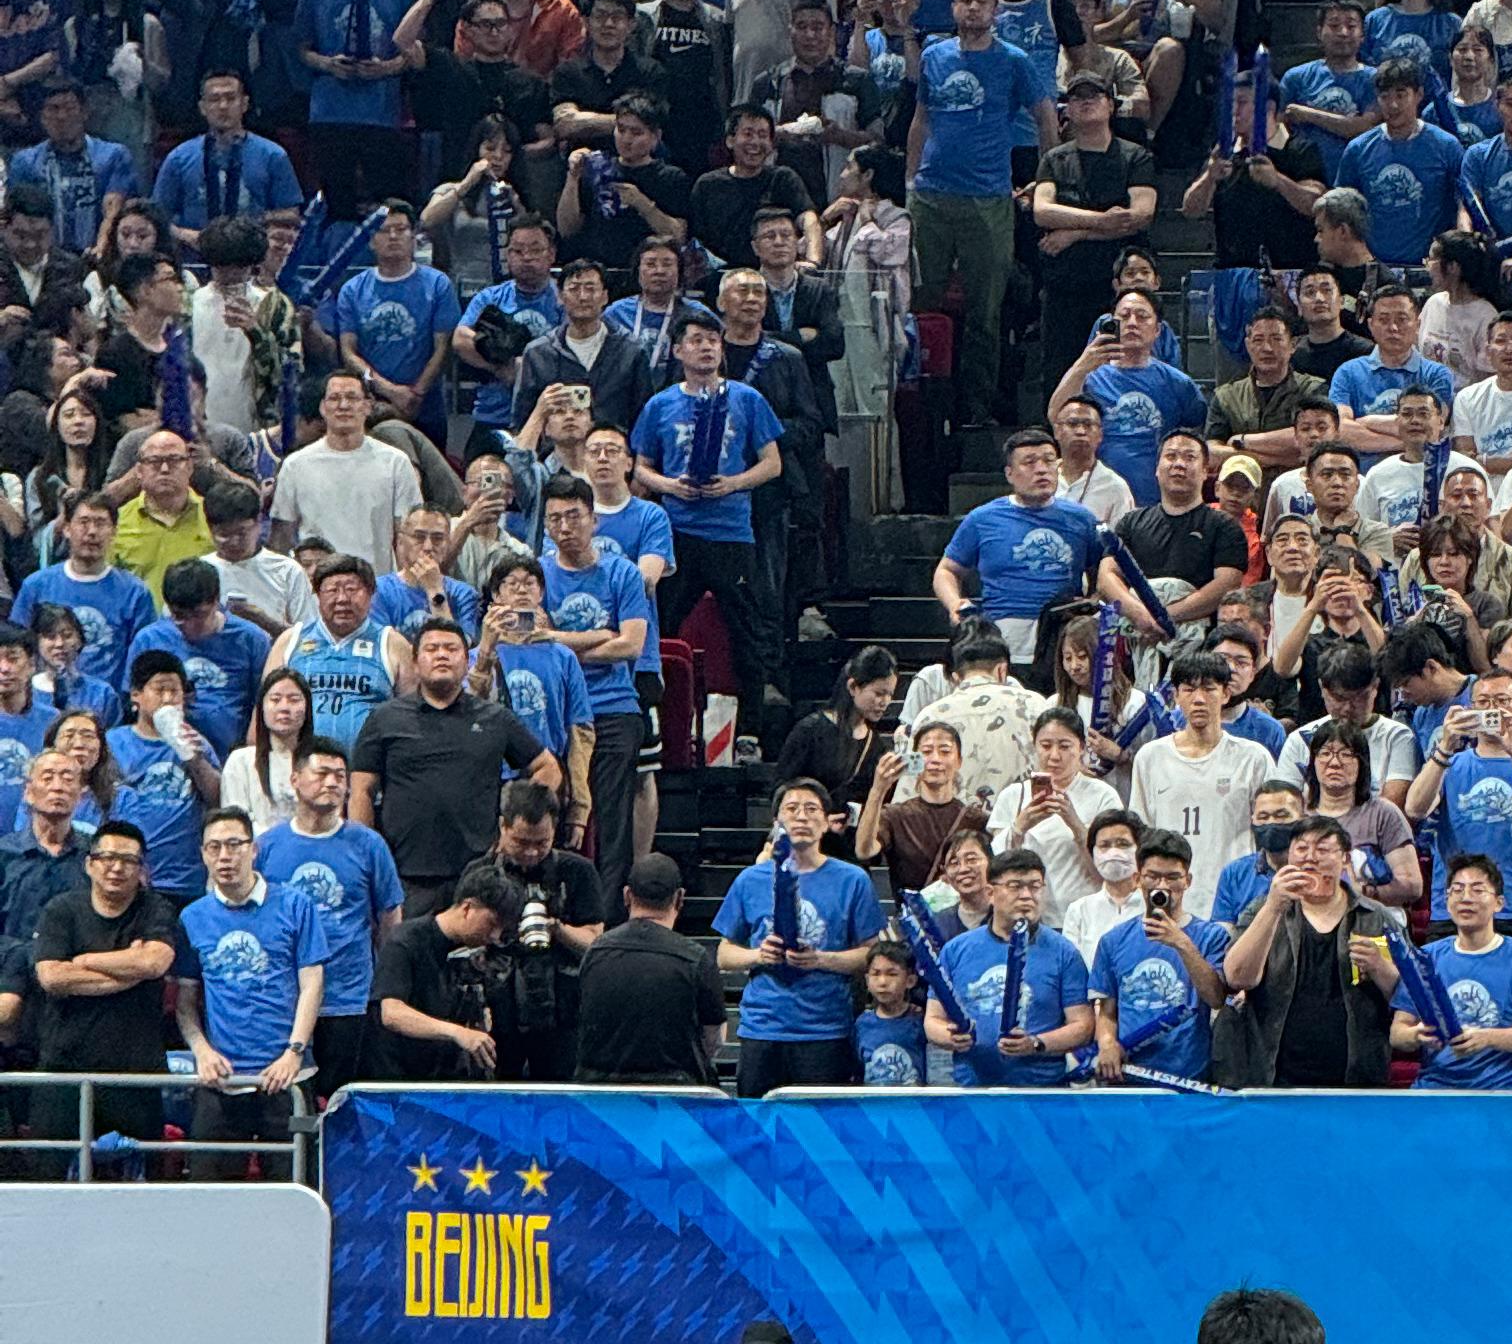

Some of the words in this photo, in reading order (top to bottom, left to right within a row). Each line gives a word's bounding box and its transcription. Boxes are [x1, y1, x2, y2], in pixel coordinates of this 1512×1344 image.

[316, 694, 343, 716] 20
[1182, 805, 1200, 836] 11
[404, 1211, 552, 1320] BEIJING
